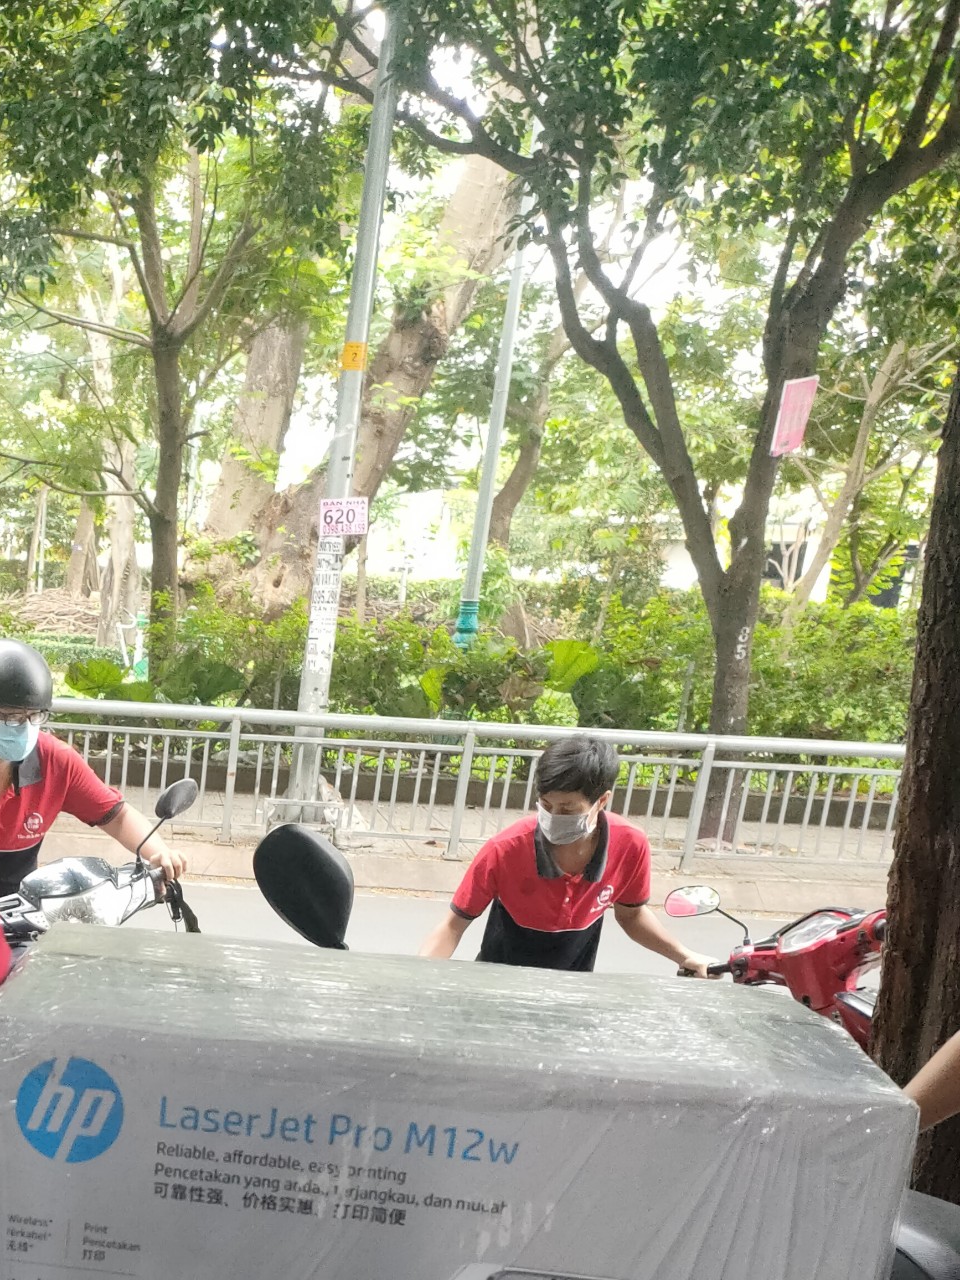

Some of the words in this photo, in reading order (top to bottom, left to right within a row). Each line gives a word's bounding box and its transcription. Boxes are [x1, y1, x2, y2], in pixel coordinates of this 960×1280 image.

[324, 509, 355, 524] 620
[159, 1095, 317, 1144] LaserJet
[328, 1114, 393, 1152] Pro
[403, 1122, 520, 1165] M12w
[156, 1141, 219, 1163] Reliable,
[223, 1149, 305, 1172] affordable,
[347, 1165, 407, 1184] prnting
[154, 1162, 241, 1184] Pencetakan
[244, 1176, 280, 1194] yang
[424, 1193, 452, 1208] dan
[84, 1222, 108, 1234] Print
